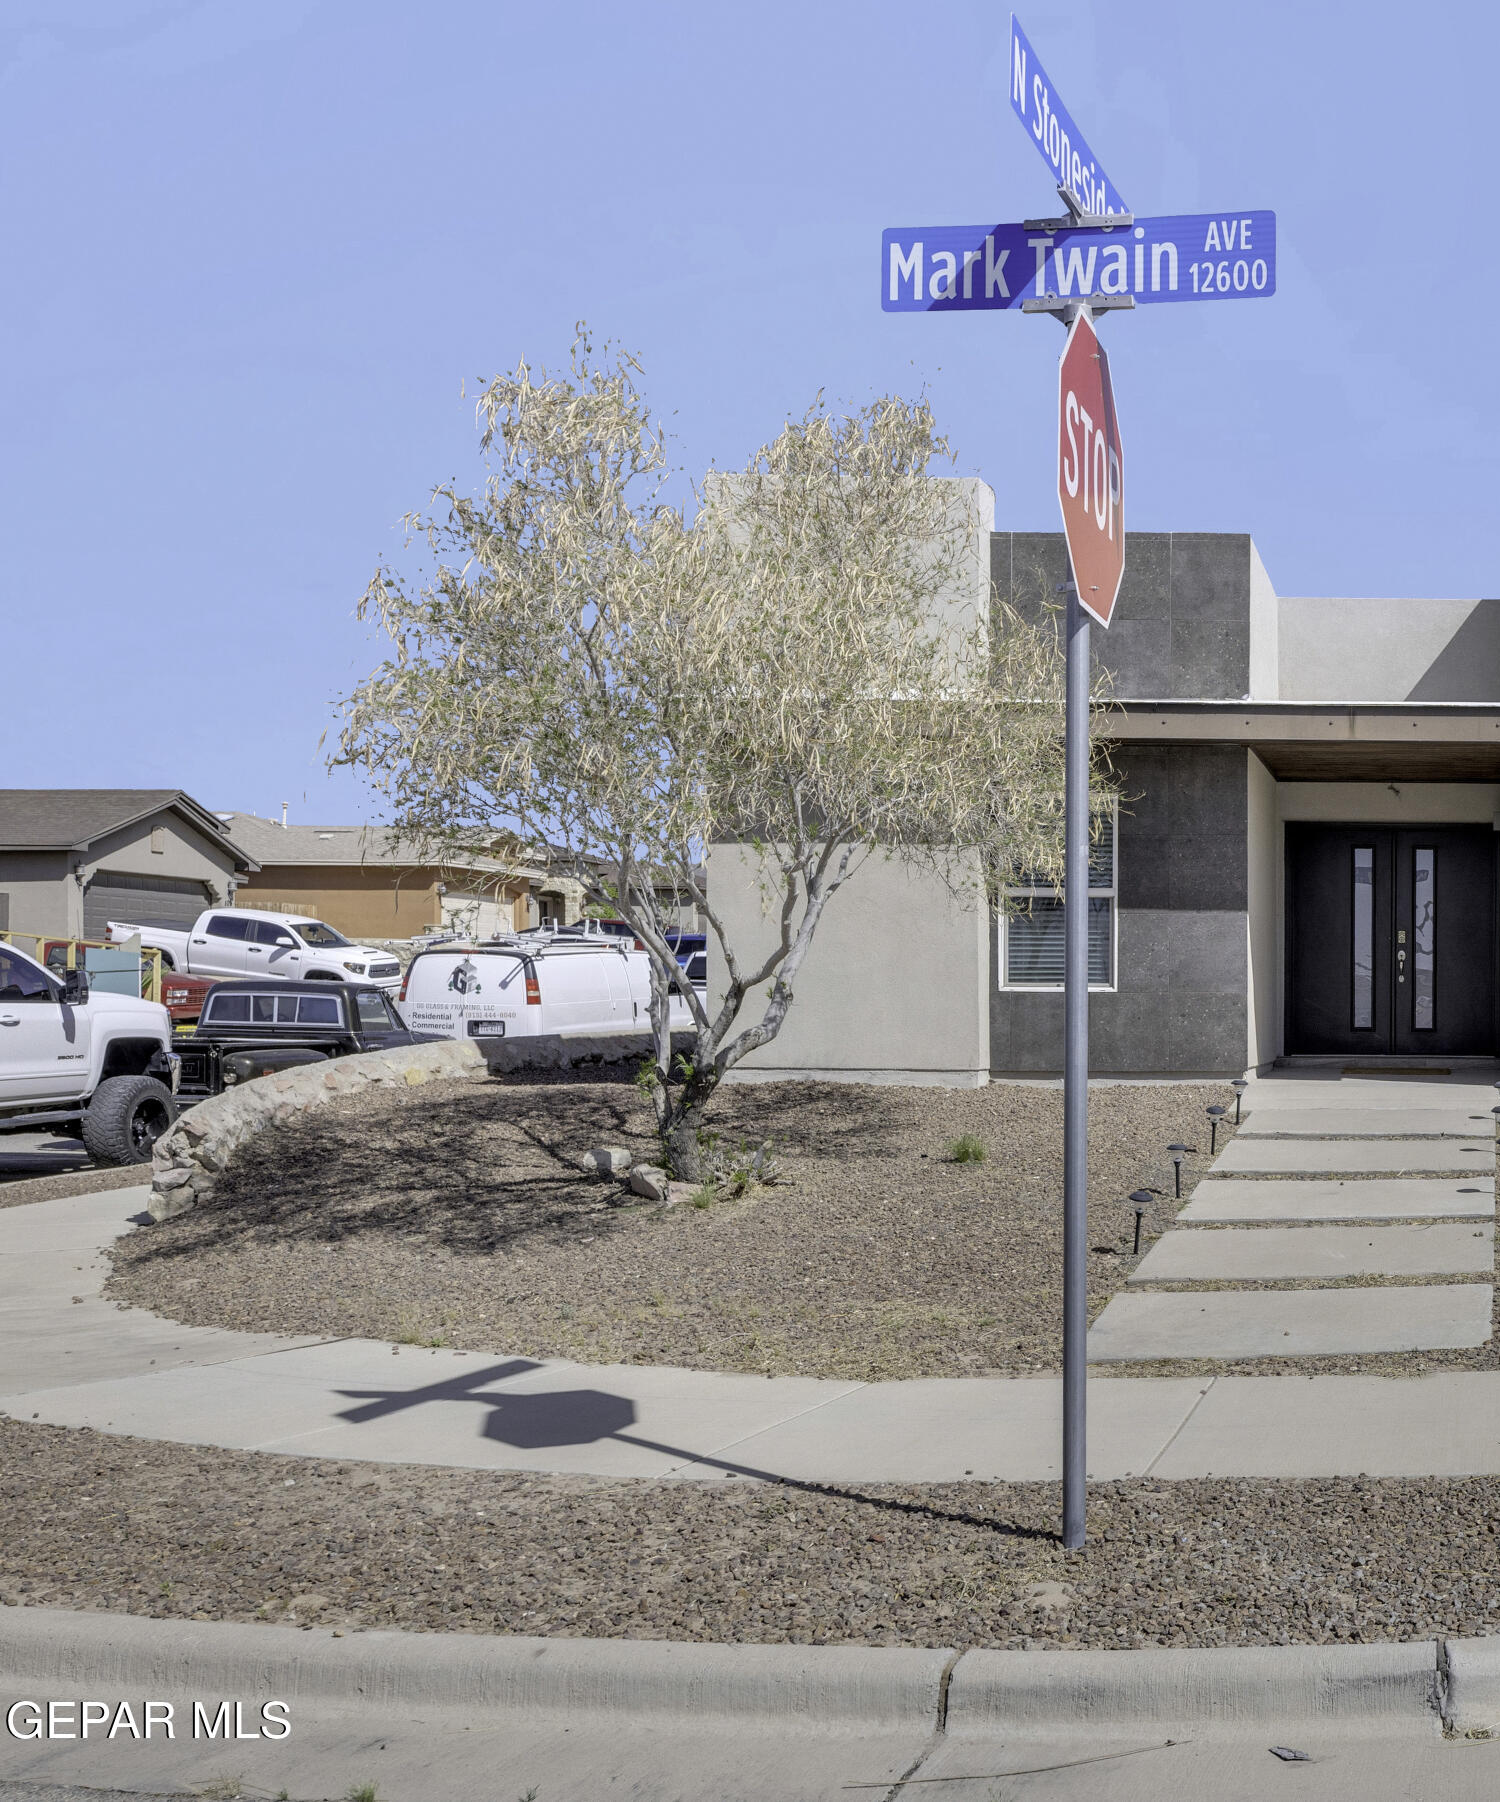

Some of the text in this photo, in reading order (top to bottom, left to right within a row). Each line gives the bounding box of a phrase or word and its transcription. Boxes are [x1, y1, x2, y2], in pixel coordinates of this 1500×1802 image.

[1013, 35, 1115, 215] N Stonesid
[1204, 219, 1253, 252] AVE
[889, 227, 1178, 301] Mark Twain
[1188, 259, 1268, 293] 12600
[1063, 390, 1121, 542] STOP
[411, 1021, 455, 1030] Commercial
[412, 1012, 452, 1021] Residential
